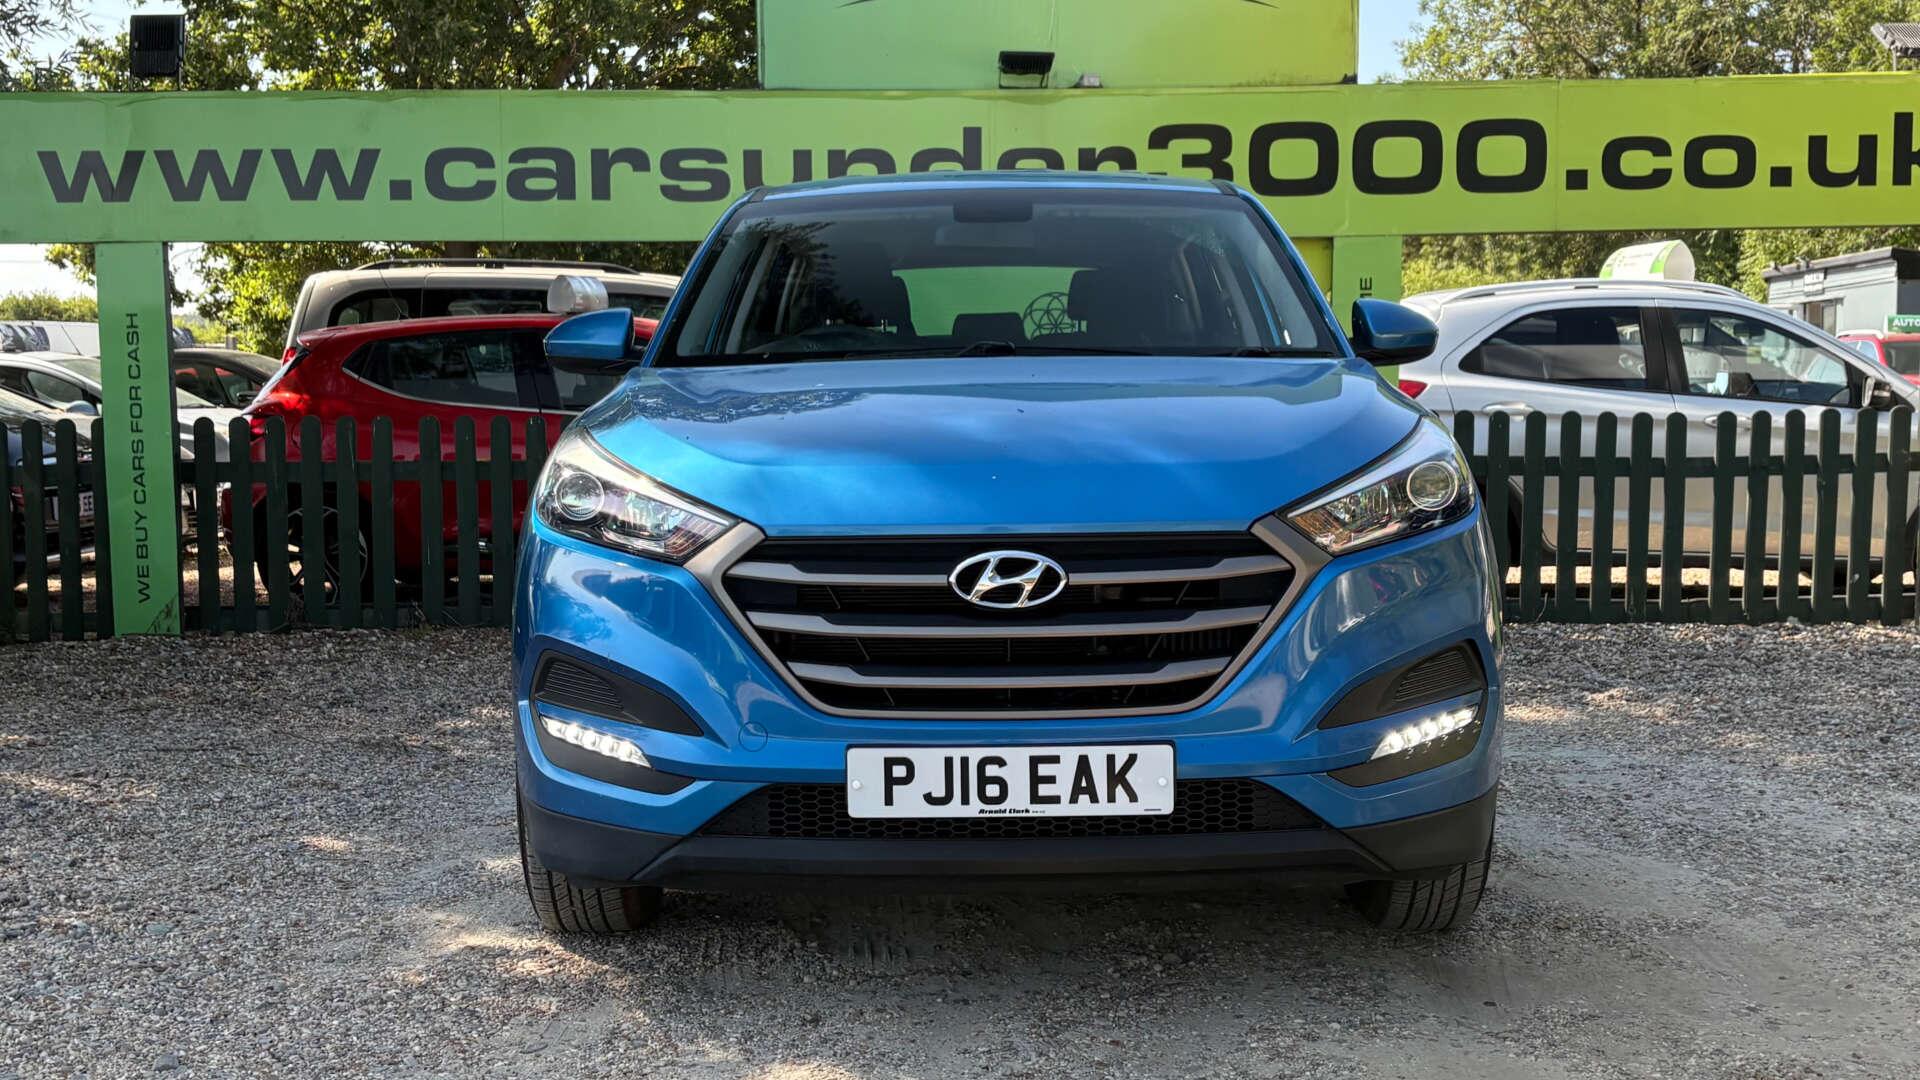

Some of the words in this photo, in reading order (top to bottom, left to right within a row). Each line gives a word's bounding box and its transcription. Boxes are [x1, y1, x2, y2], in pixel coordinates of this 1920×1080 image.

[126, 312, 141, 380] CASH
[129, 385, 144, 433] FOR
[131, 438, 147, 505] CARS
[134, 510, 149, 559] BUY
[137, 565, 151, 604] WE
[883, 755, 1009, 806] PJ16
[1029, 753, 1139, 805] EAK
